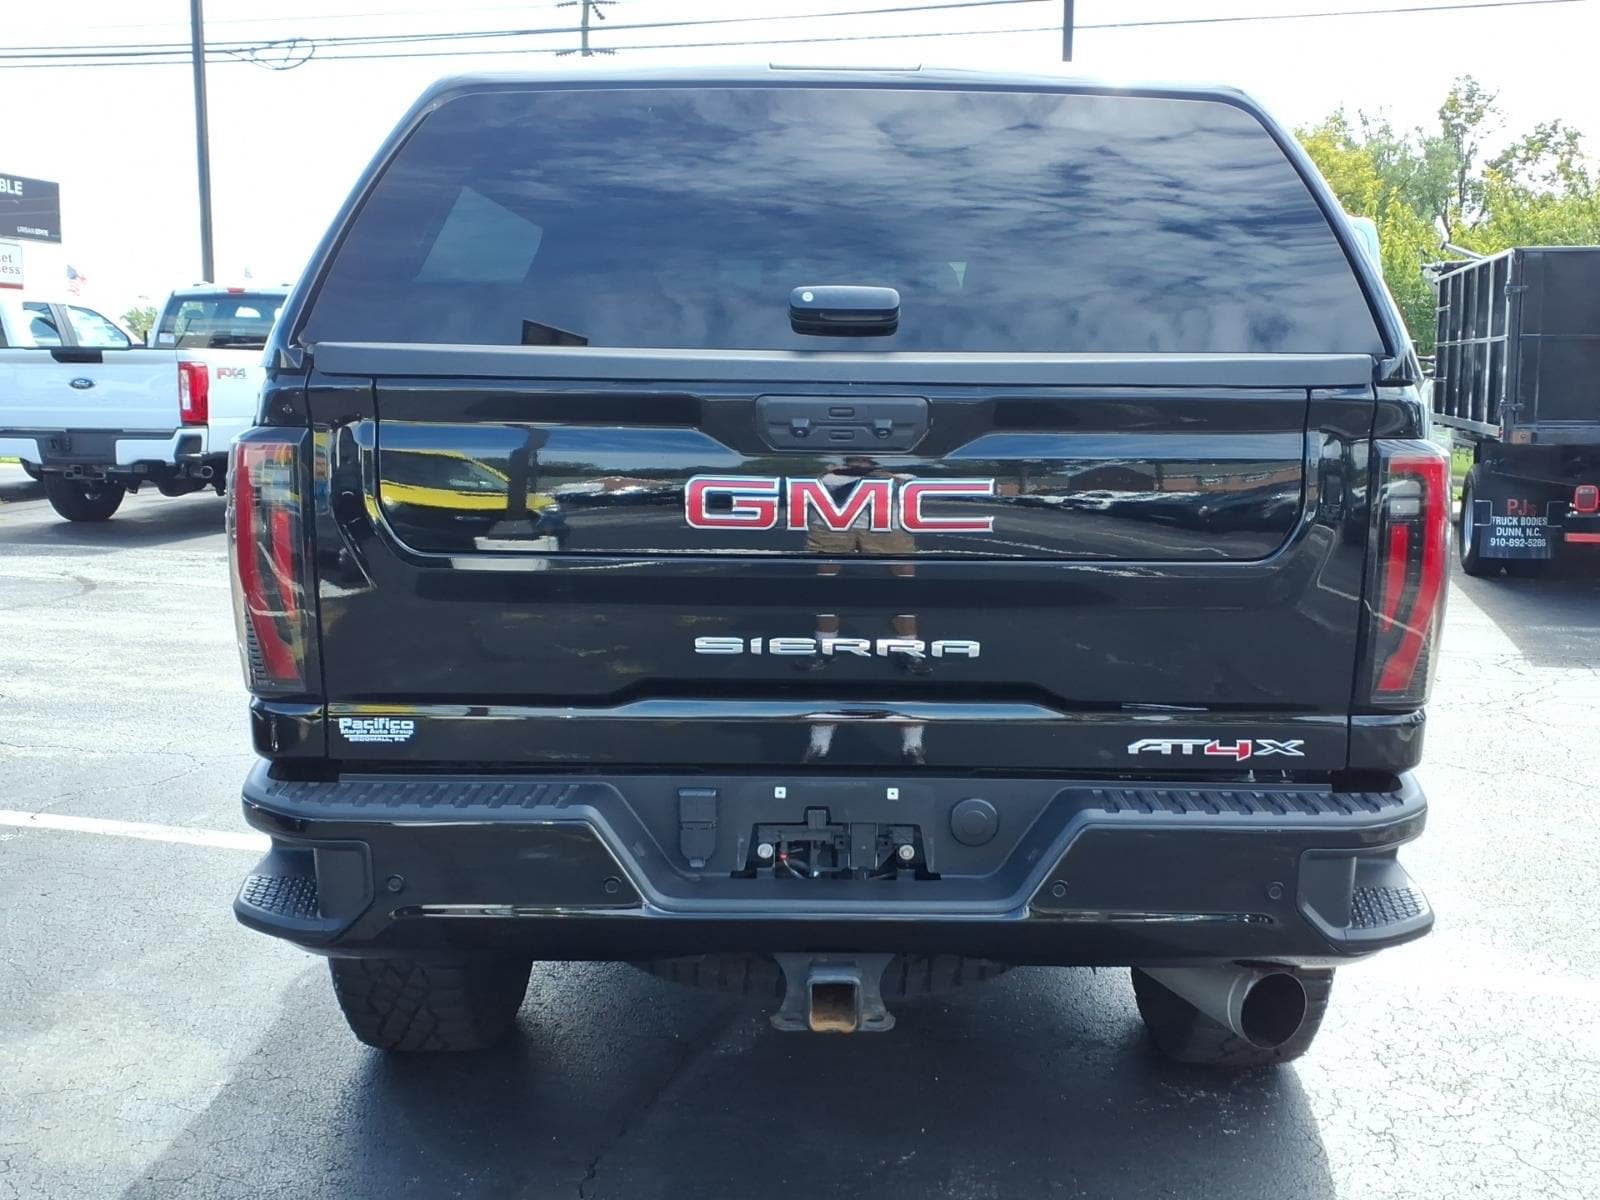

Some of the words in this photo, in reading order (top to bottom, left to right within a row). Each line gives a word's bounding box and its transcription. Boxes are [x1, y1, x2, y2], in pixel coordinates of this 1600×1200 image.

[0, 254, 12, 263] et
[0, 265, 20, 275] ess
[217, 368, 247, 379] FX4
[685, 474, 995, 533] GMC
[1491, 516, 1518, 526] TRUCK
[1520, 516, 1548, 526] BODIES
[1496, 528, 1524, 537] DUNN,
[1526, 528, 1541, 537] N.C.
[694, 637, 981, 658] SIERRA
[339, 718, 414, 729] Pacifico
[1128, 739, 1305, 761] AT4X
